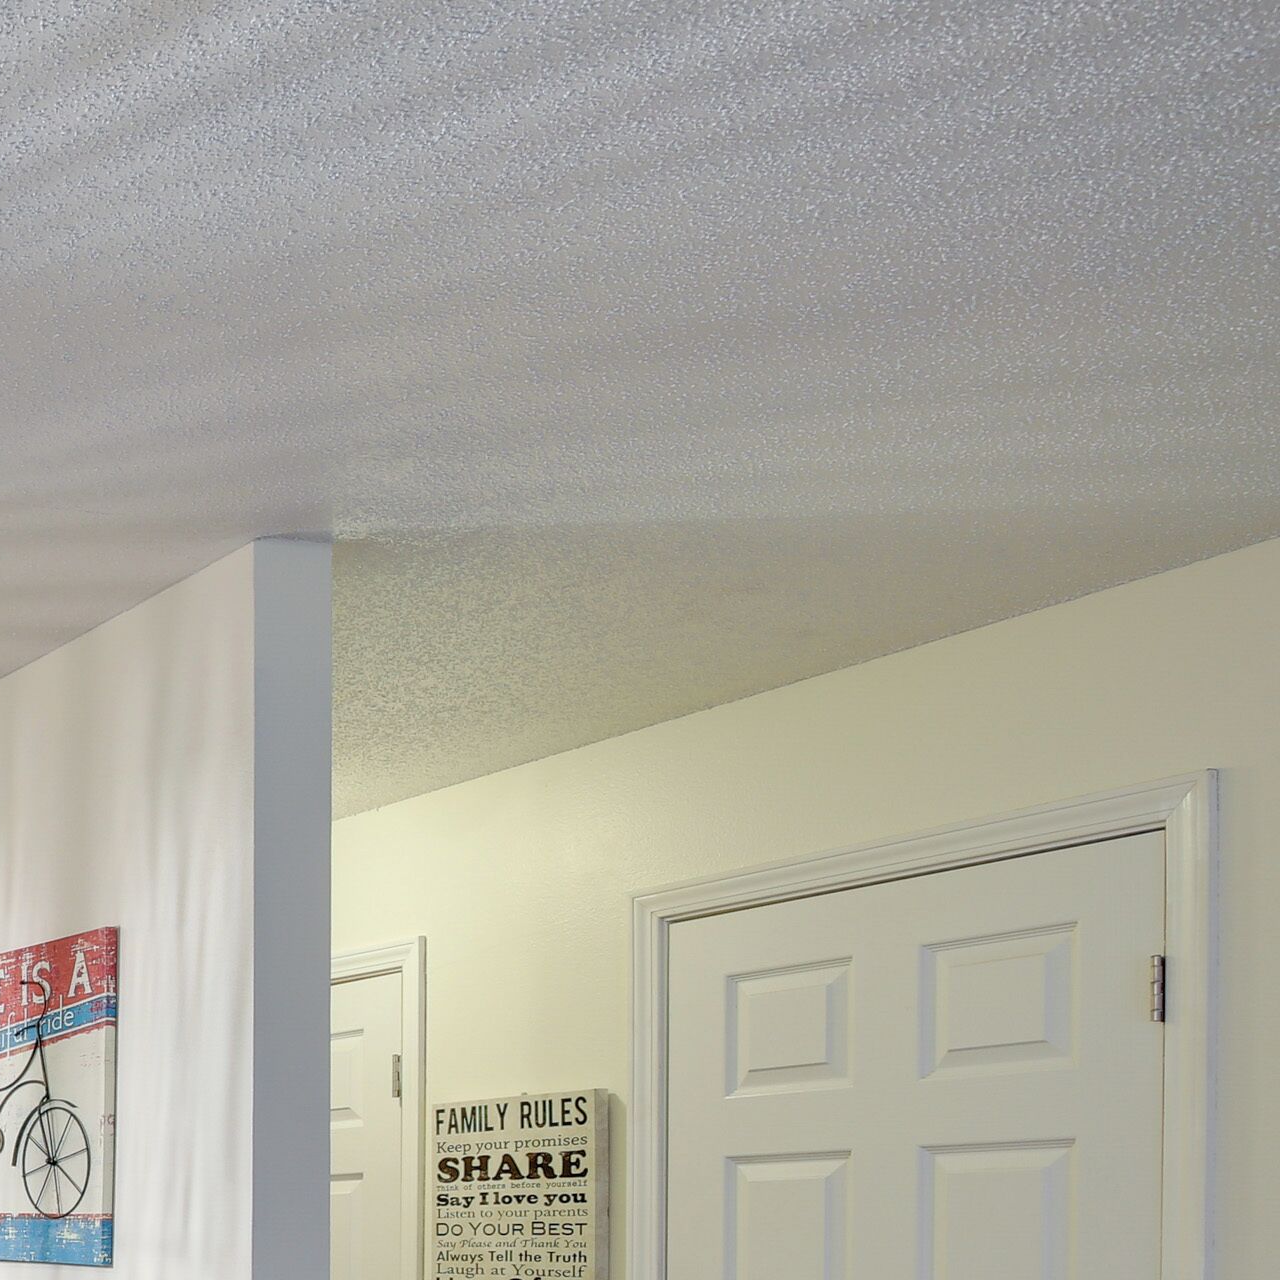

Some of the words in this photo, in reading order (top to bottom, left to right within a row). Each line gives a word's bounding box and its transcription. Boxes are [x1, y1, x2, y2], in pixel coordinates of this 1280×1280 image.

[20, 960, 53, 1006] IS
[67, 950, 93, 997] A
[39, 994, 74, 1035] ride
[436, 1103, 508, 1135] FAMILY
[520, 1096, 588, 1129] RULES
[436, 1141, 471, 1155] Keep
[476, 1139, 510, 1154] your
[514, 1134, 588, 1151] promises
[437, 1150, 588, 1183] SHARE
[477, 1182, 506, 1190] others
[546, 1180, 588, 1189] yourself
[436, 1193, 475, 1208] Say
[479, 1192, 489, 1205] I
[493, 1192, 539, 1205] love
[544, 1192, 588, 1206] you
[437, 1208, 476, 1219] Listen
[480, 1209, 493, 1218] to
[497, 1209, 530, 1221] your
[534, 1207, 589, 1220] parents
[436, 1222, 463, 1236] DO
[468, 1222, 524, 1236] YOUR
[531, 1221, 588, 1236] BEST
[437, 1240, 456, 1250] Say
[459, 1239, 492, 1248] Please
[495, 1238, 518, 1248] and
[520, 1238, 560, 1248] Thank
[564, 1239, 587, 1249] You
[436, 1250, 484, 1264] Always
[488, 1250, 513, 1262] Tell
[518, 1251, 542, 1262] the
[547, 1251, 587, 1263] Truth
[437, 1263, 484, 1279] Laugh
[491, 1267, 506, 1276] at
[512, 1264, 587, 1278] Yourself
